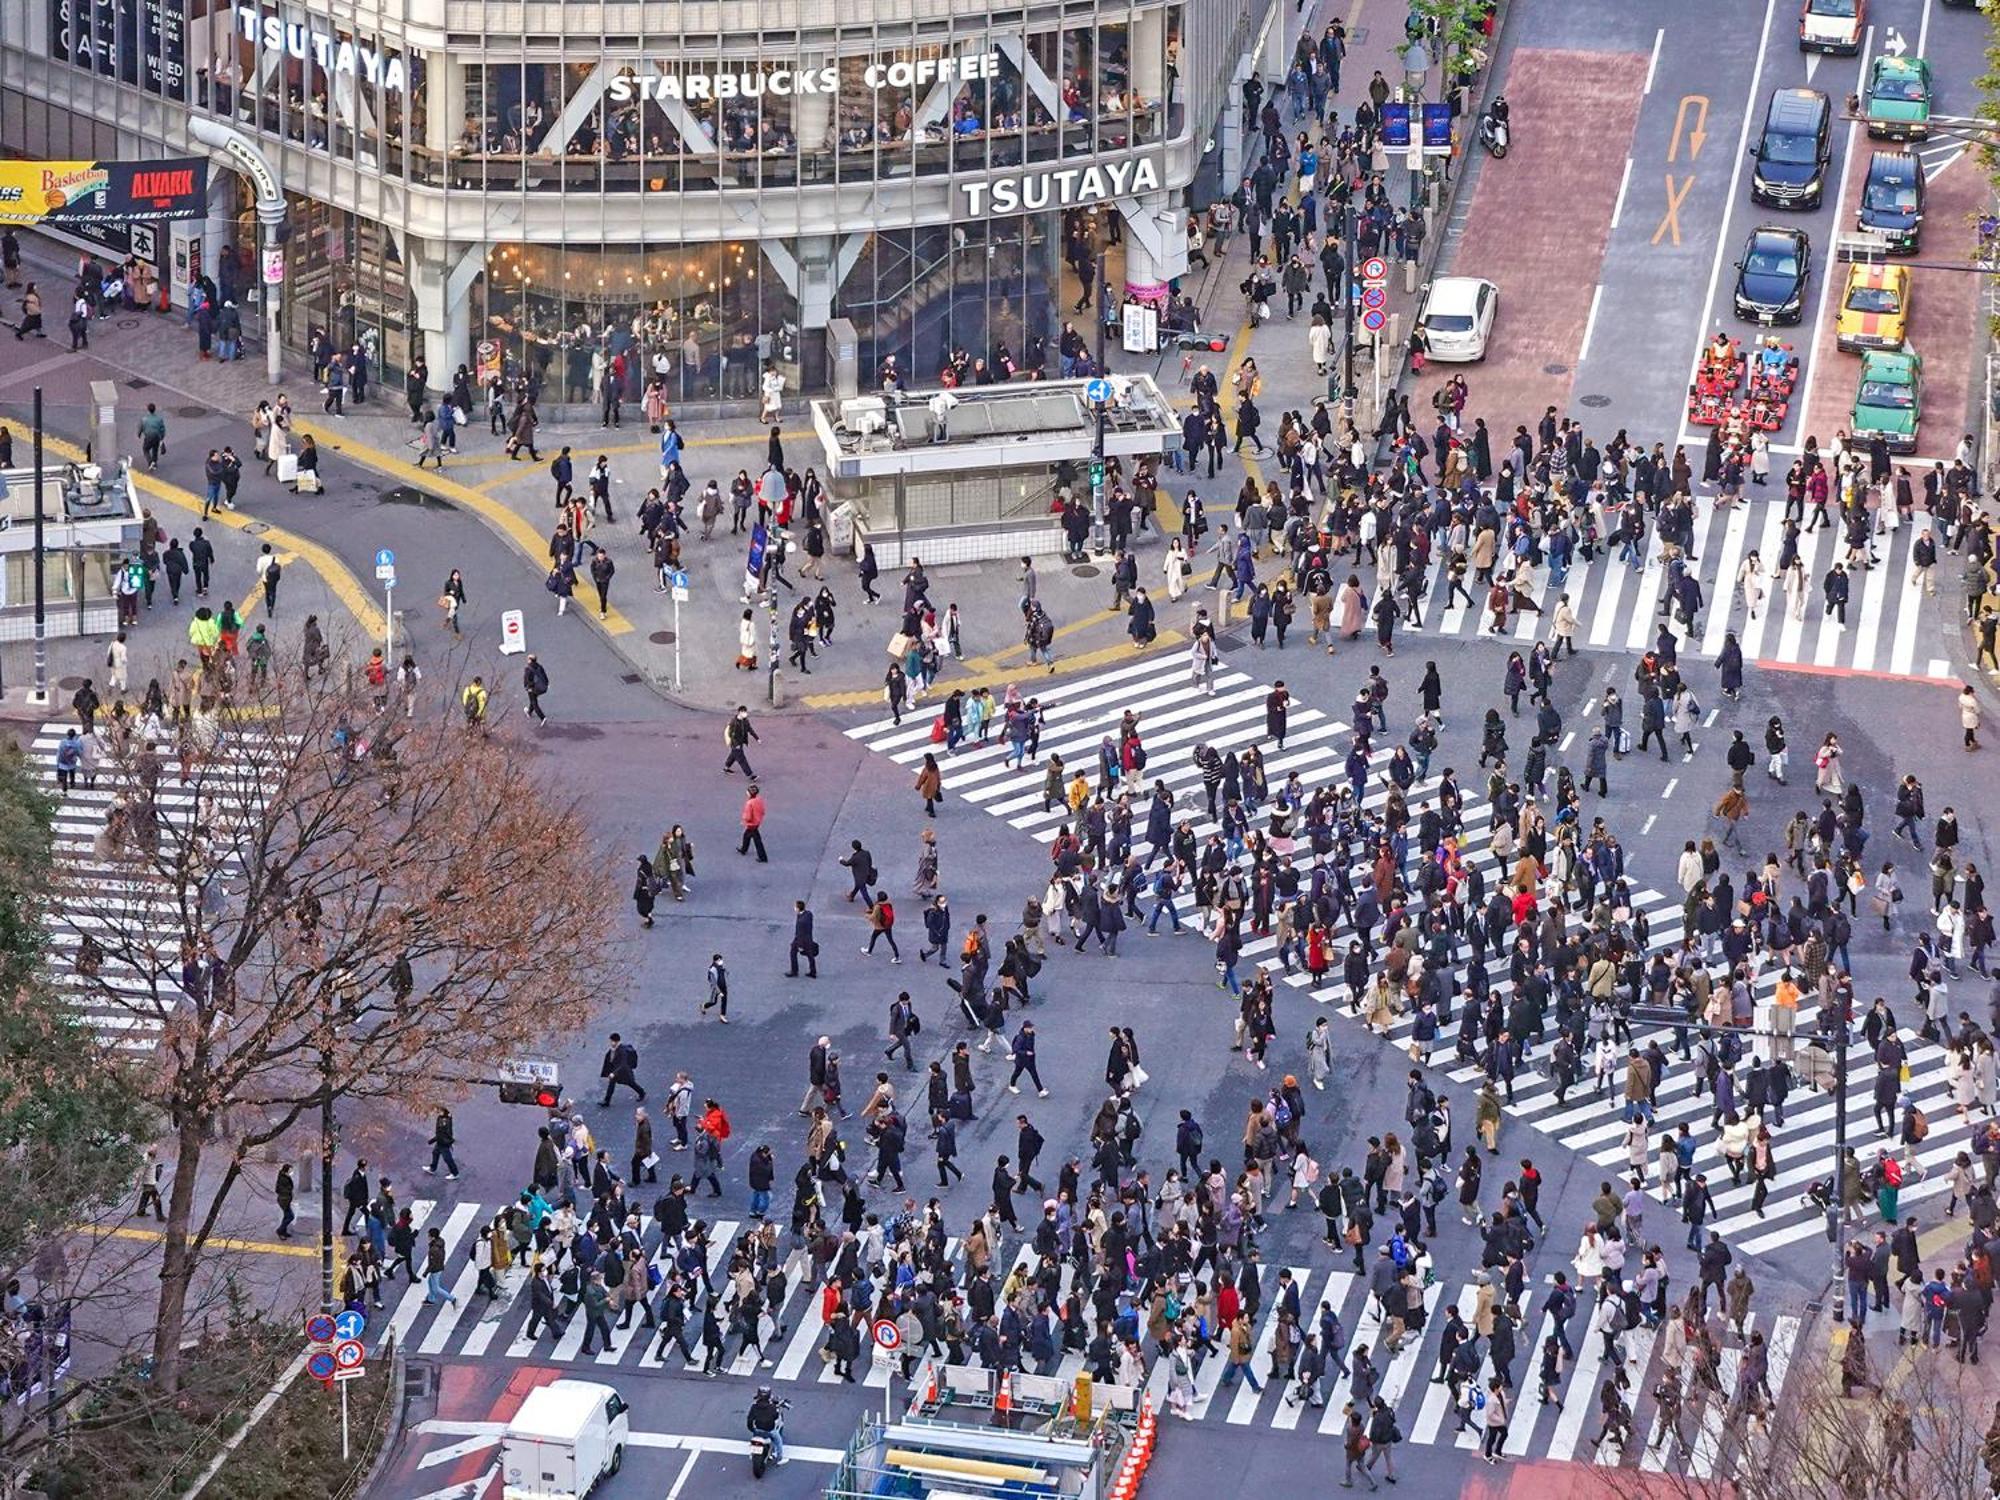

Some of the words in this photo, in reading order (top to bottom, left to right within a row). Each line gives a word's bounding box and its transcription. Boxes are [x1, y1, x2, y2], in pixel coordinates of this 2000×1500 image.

[147, 54, 183, 77] WIED
[239, 7, 404, 92] TSUTAYA
[609, 67, 838, 100] STARBUCKS
[864, 53, 1000, 88] COFFEE
[131, 170, 193, 198] ALVARK
[962, 158, 1159, 216] TSUTAYA
[134, 231, 152, 253] 本
